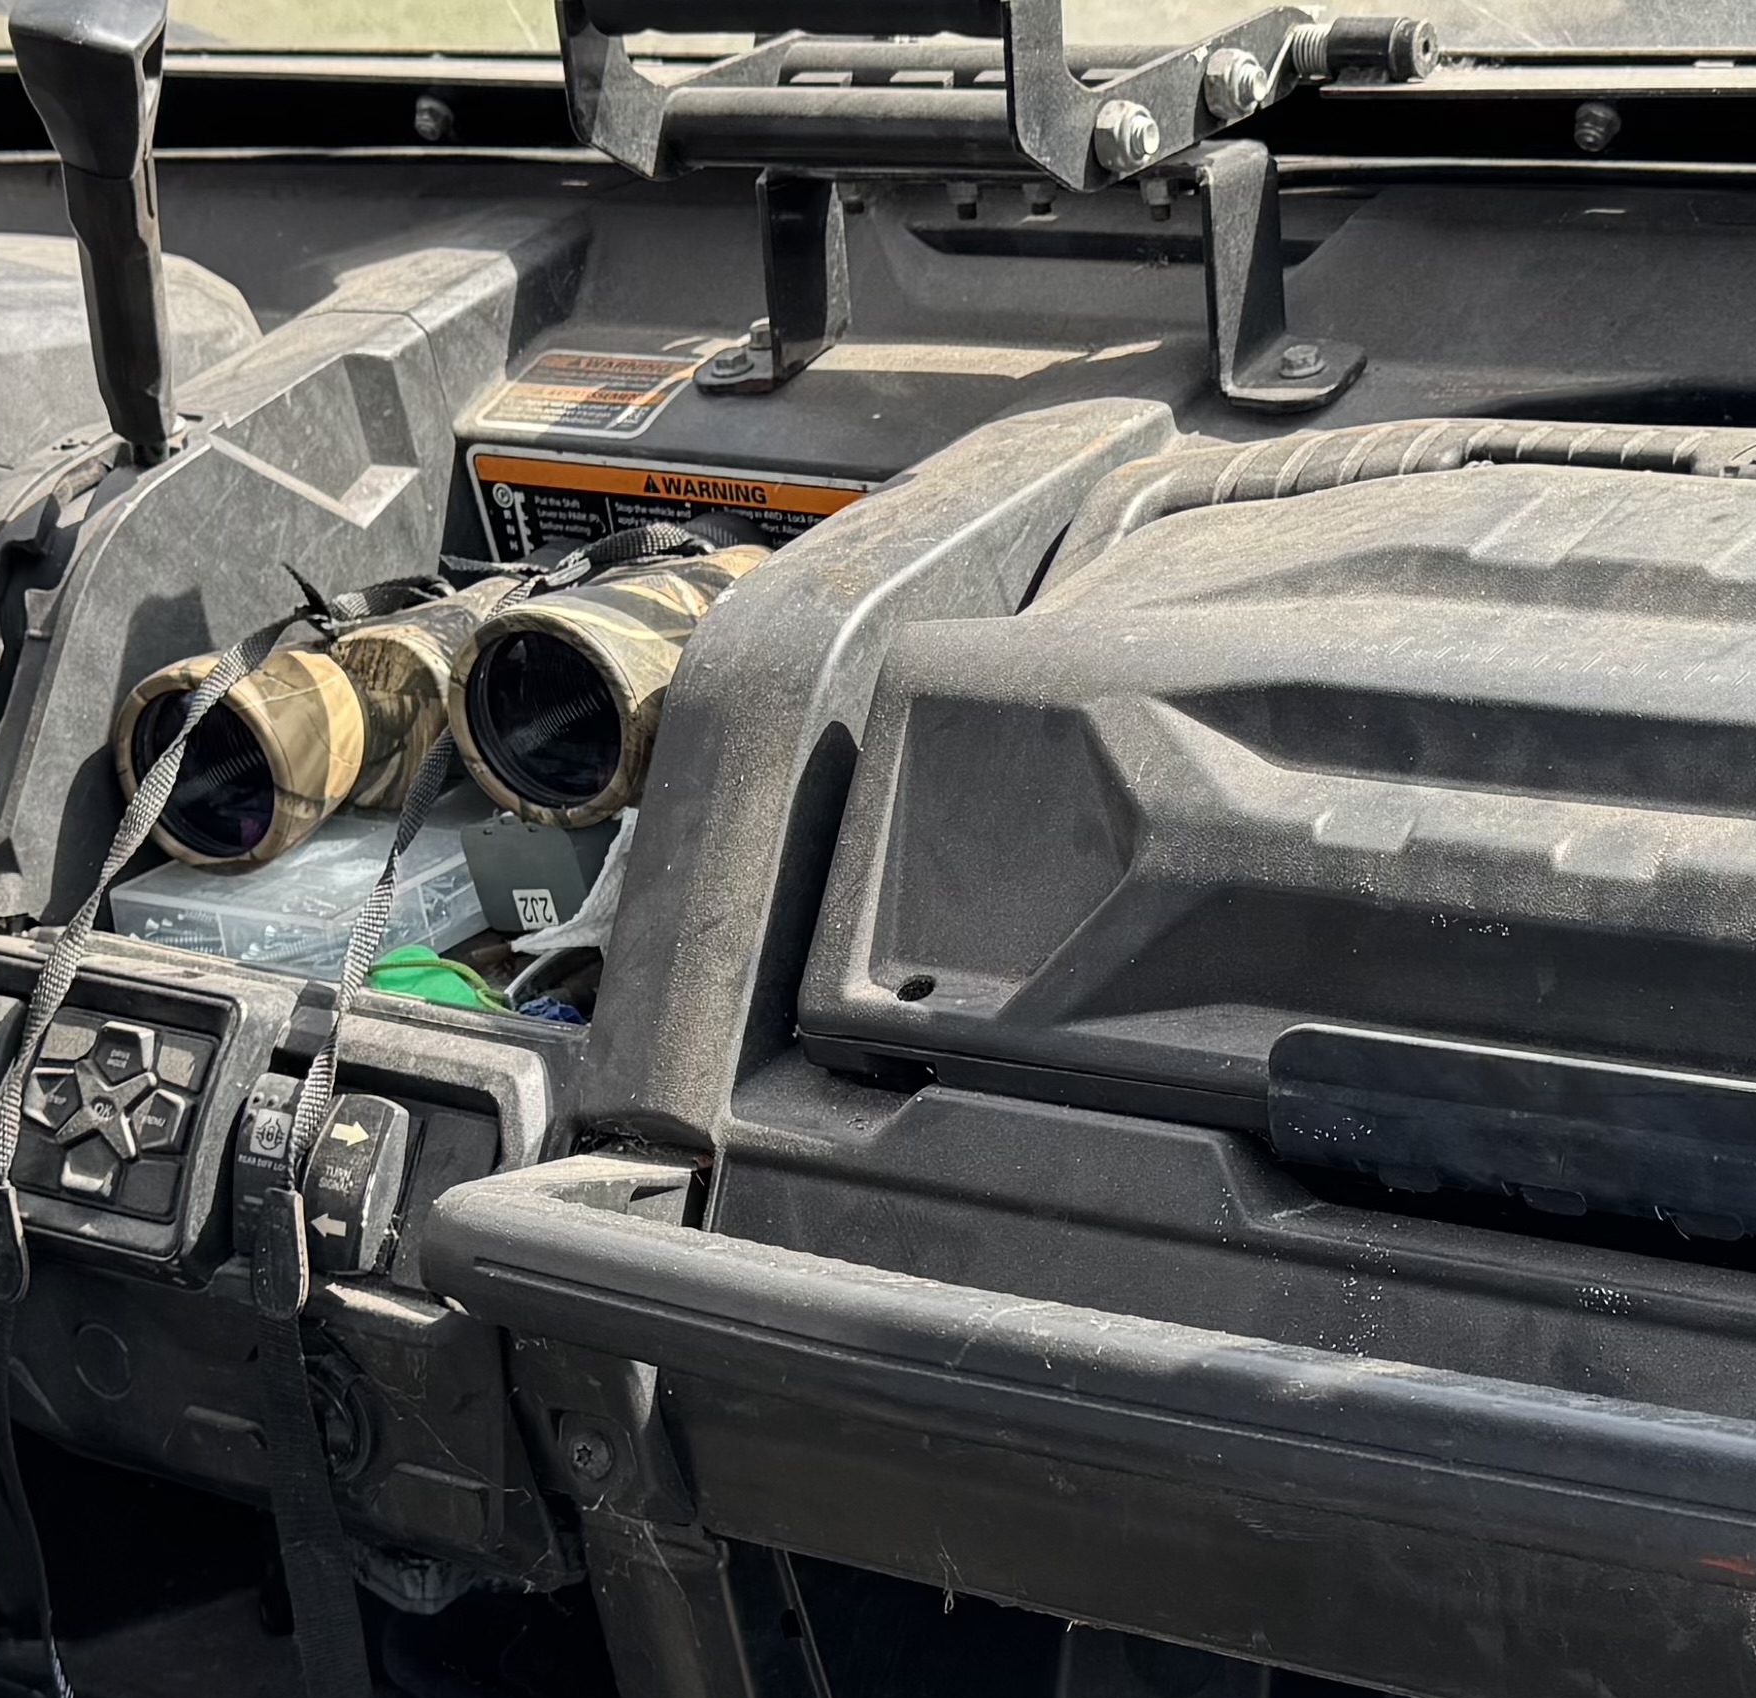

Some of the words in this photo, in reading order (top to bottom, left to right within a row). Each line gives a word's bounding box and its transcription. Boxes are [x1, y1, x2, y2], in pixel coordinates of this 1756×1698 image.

[662, 476, 768, 504] WARNING
[94, 1102, 115, 1121] OK
[238, 1154, 256, 1165] REAR
[325, 1164, 353, 1181] TURN
[318, 1176, 351, 1193] SIGNAL
